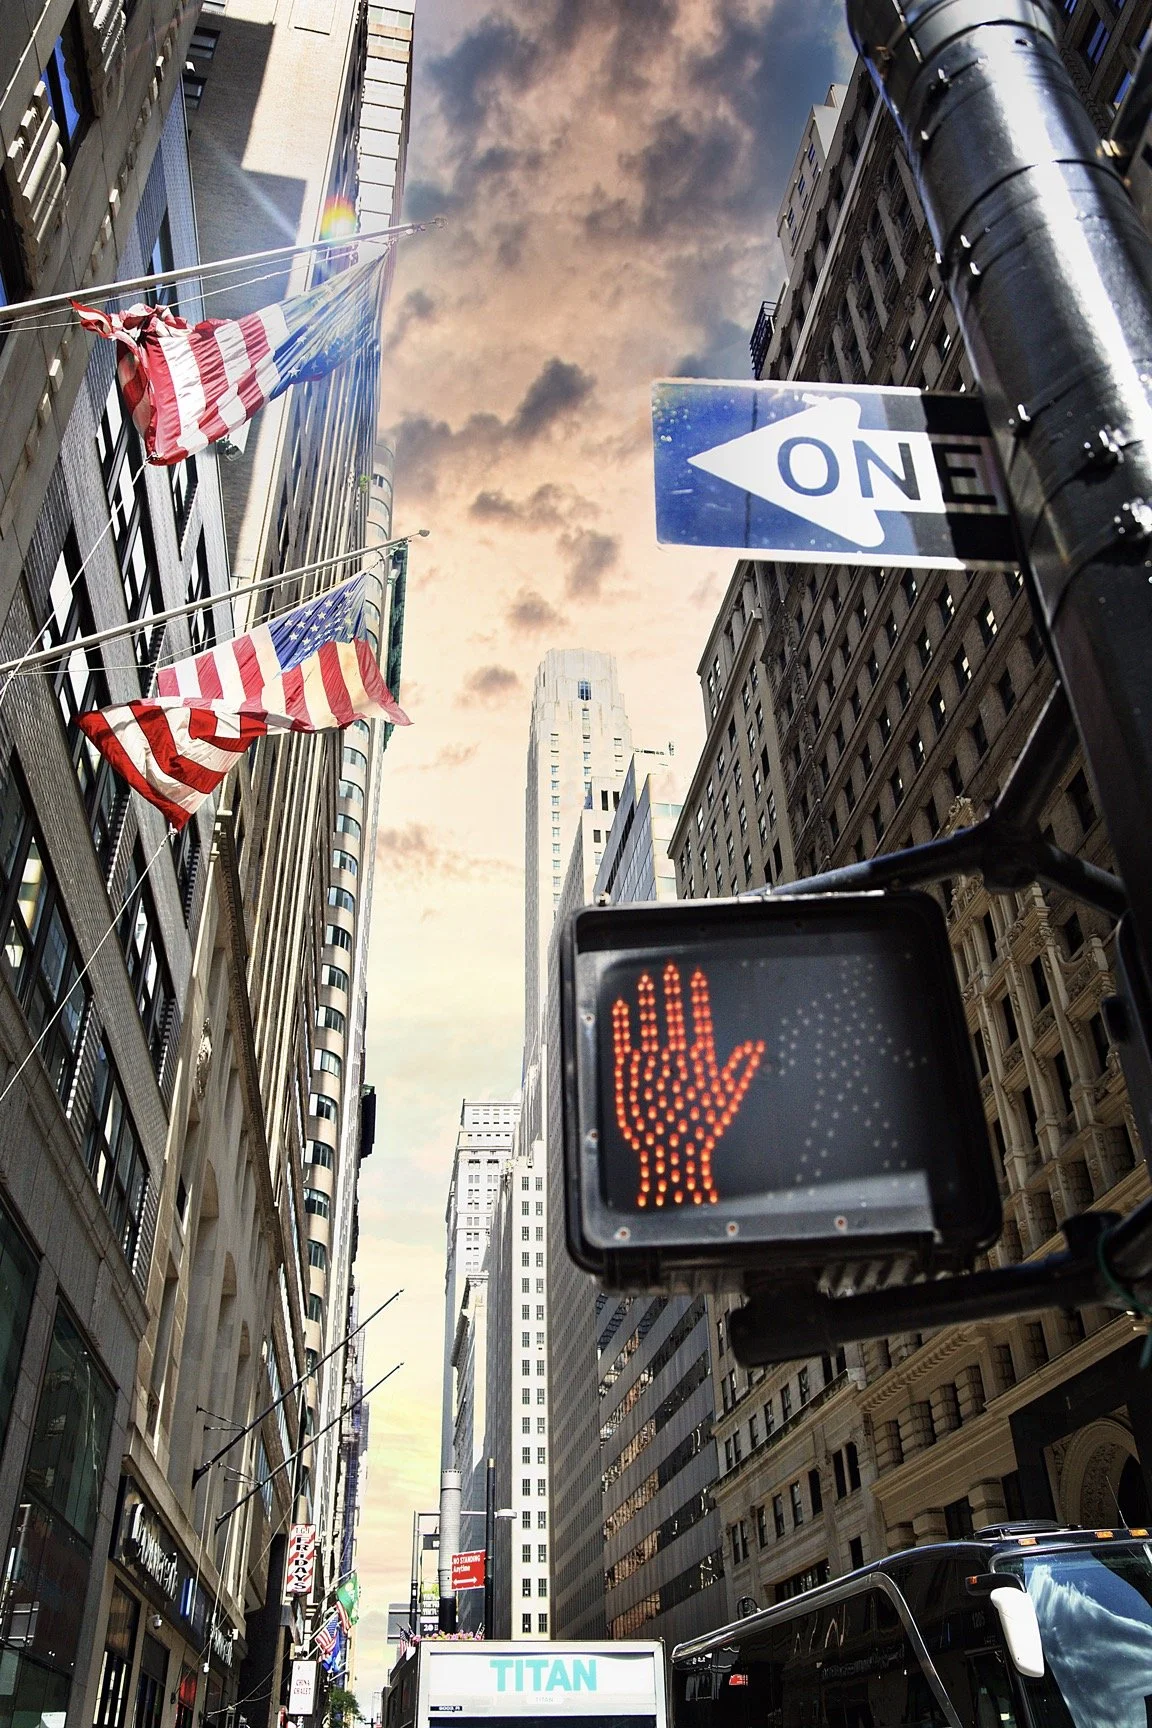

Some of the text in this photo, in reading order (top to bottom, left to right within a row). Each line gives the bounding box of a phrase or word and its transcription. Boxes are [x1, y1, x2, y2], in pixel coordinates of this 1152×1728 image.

[777, 436, 997, 506] ONE
[453, 1554, 481, 1565] NO STANDING
[453, 1565, 471, 1574] Anytime
[489, 1659, 597, 1692] TITAN
